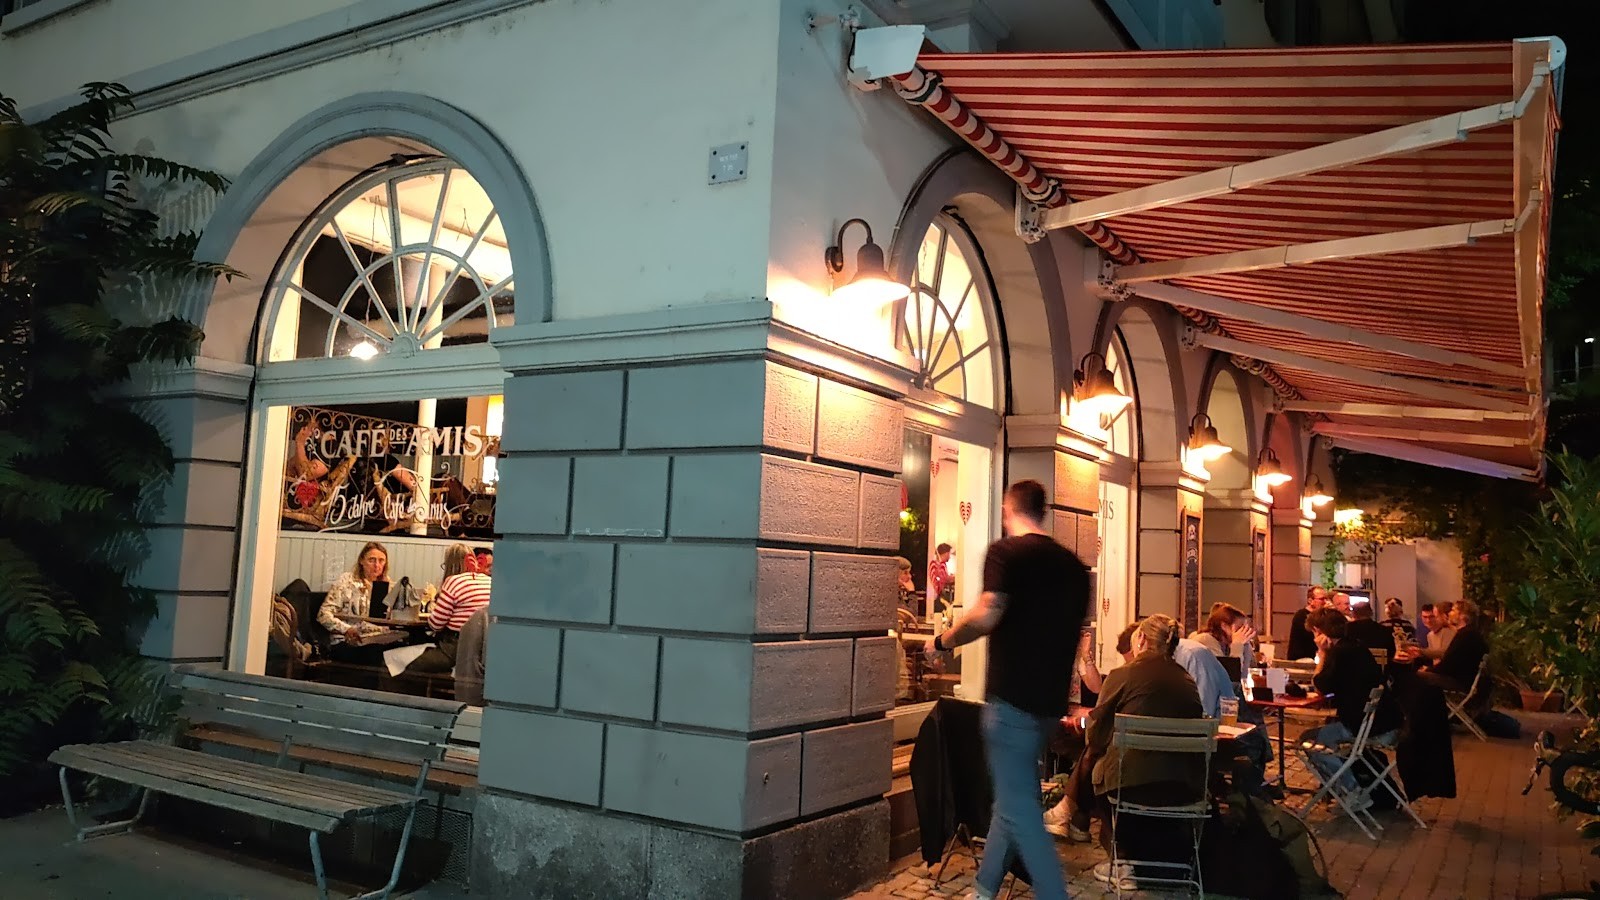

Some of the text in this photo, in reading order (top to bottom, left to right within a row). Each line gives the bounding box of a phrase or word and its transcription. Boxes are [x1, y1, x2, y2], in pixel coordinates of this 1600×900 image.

[320, 423, 483, 459] CAFÉ DES AMIS
[384, 492, 405, 525] Café
[1097, 499, 1115, 520] MIS
